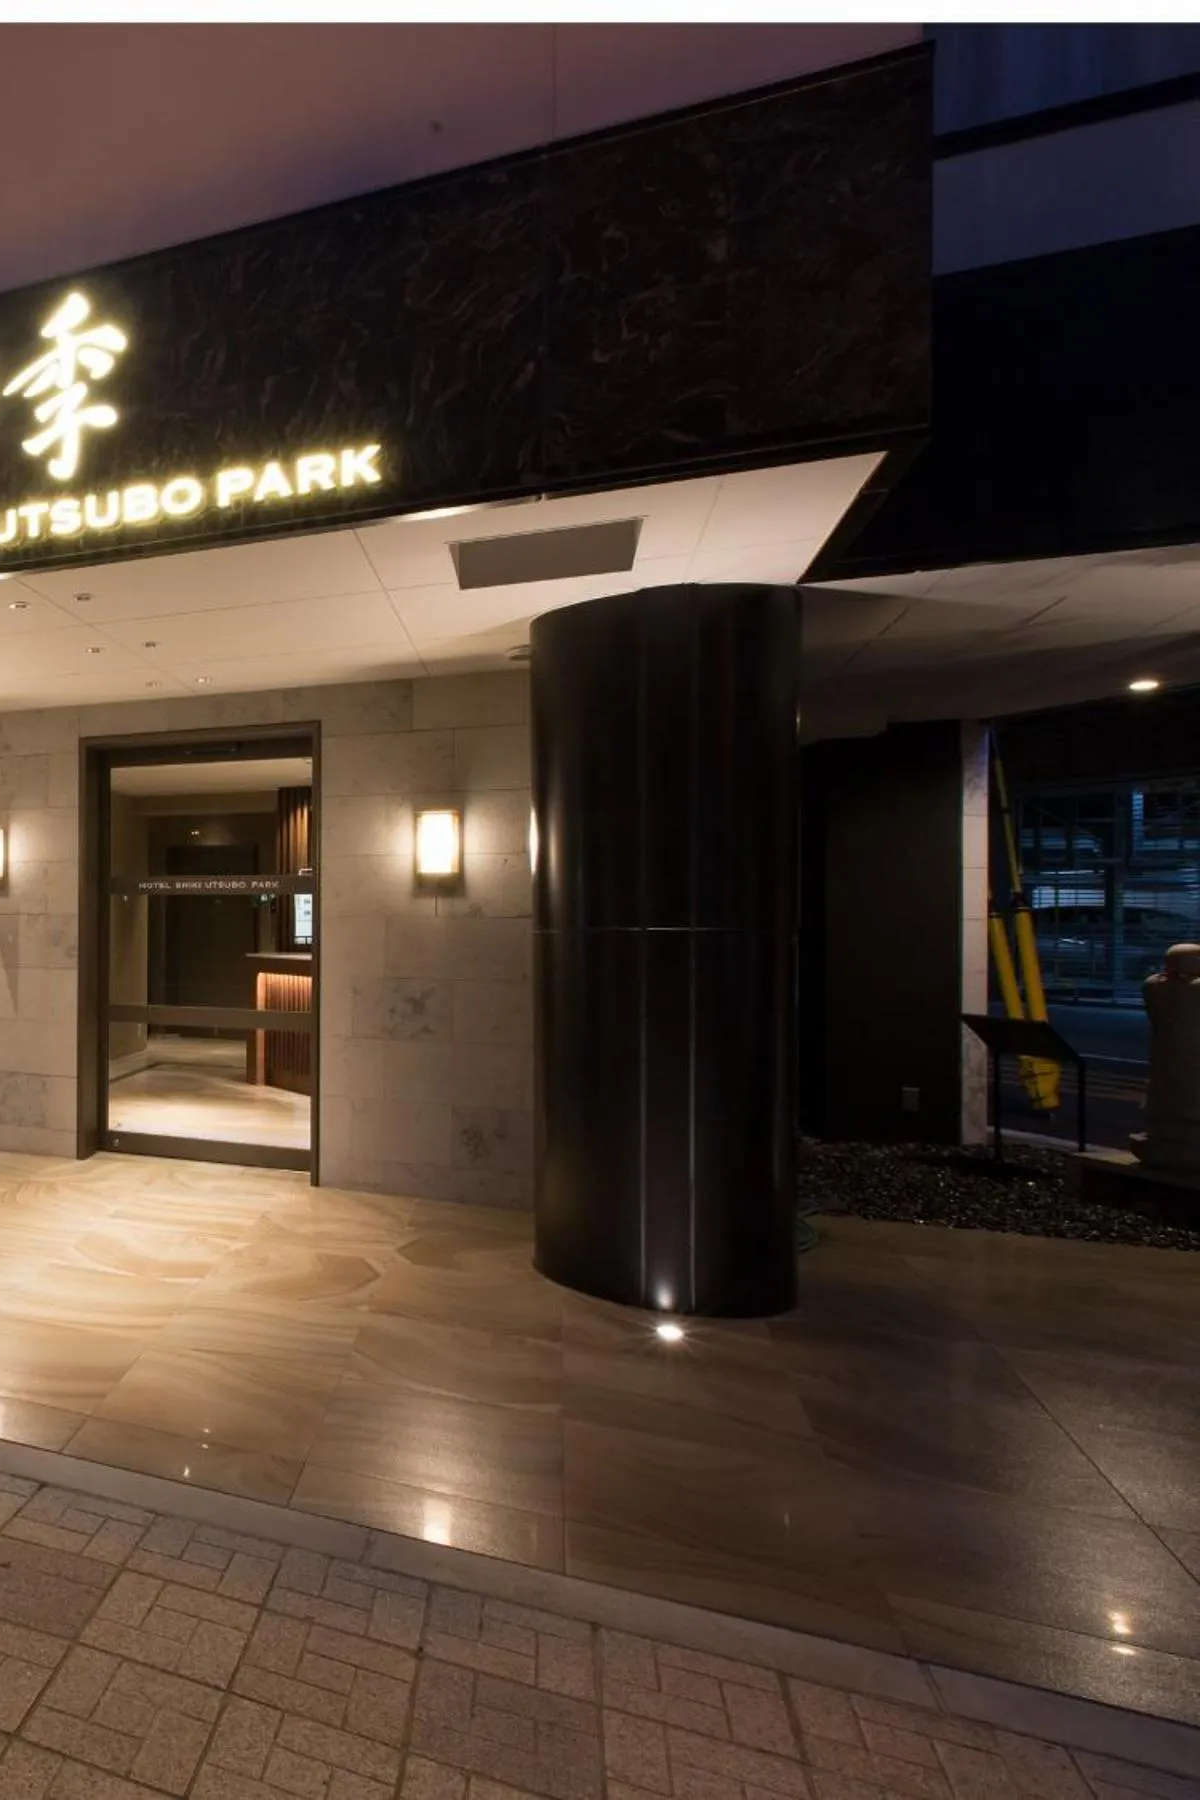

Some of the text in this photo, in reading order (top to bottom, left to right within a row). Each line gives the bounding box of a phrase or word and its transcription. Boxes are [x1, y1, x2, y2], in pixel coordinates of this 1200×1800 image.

[215, 444, 382, 508] PARK
[138, 880, 280, 889] HOTEL SHIKI UTSUBO PARK
